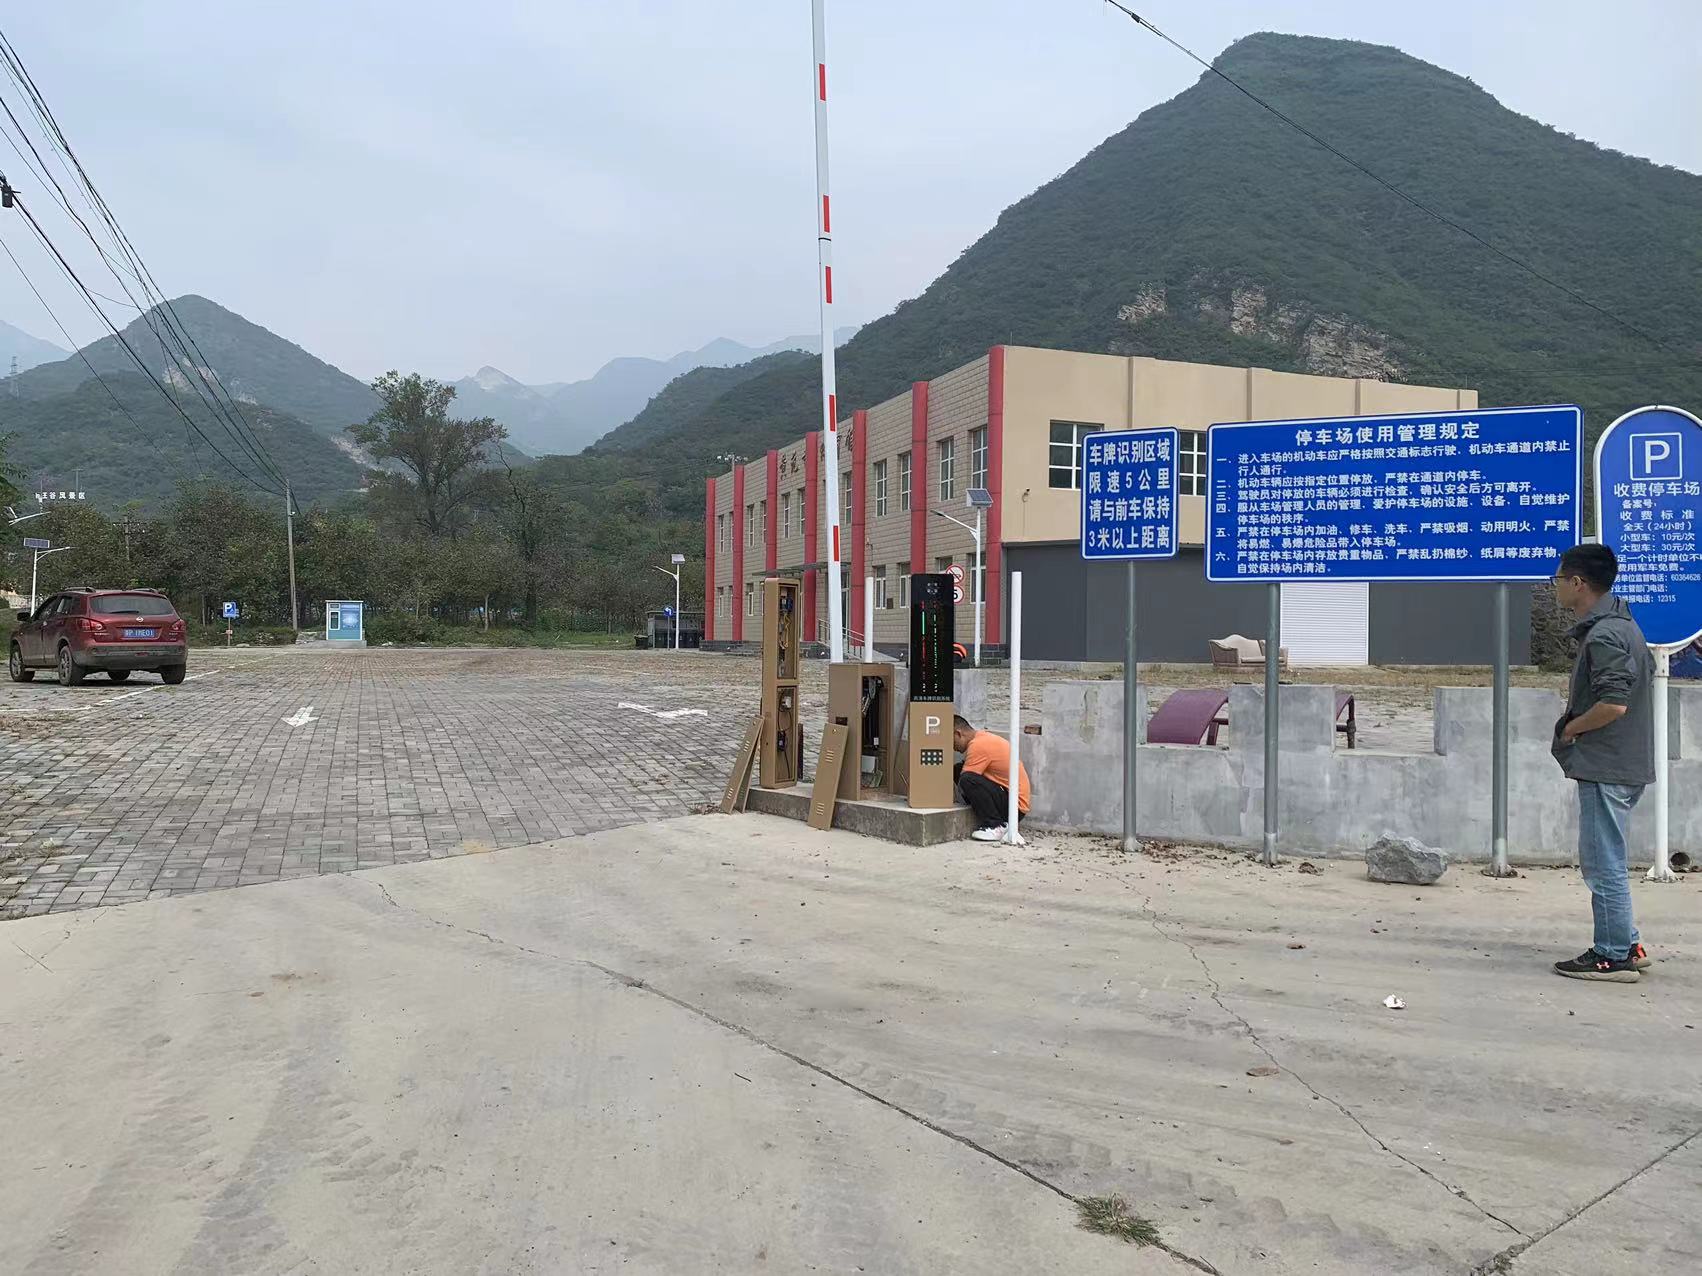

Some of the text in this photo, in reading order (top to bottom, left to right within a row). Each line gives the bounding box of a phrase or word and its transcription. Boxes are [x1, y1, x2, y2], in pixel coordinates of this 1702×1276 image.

[1295, 421, 1480, 447] 停车场使用管理规定
[1089, 438, 1170, 466] 车牌识别区域
[1645, 440, 1671, 474] P
[1089, 467, 1170, 494] 限速5公里
[1613, 481, 1701, 498] 收费停车场
[1089, 495, 1170, 522] 请与前车保持
[1620, 509, 1695, 521] 收费标准
[1089, 525, 1170, 551] 3米以上距离
[925, 715, 941, 736] P
